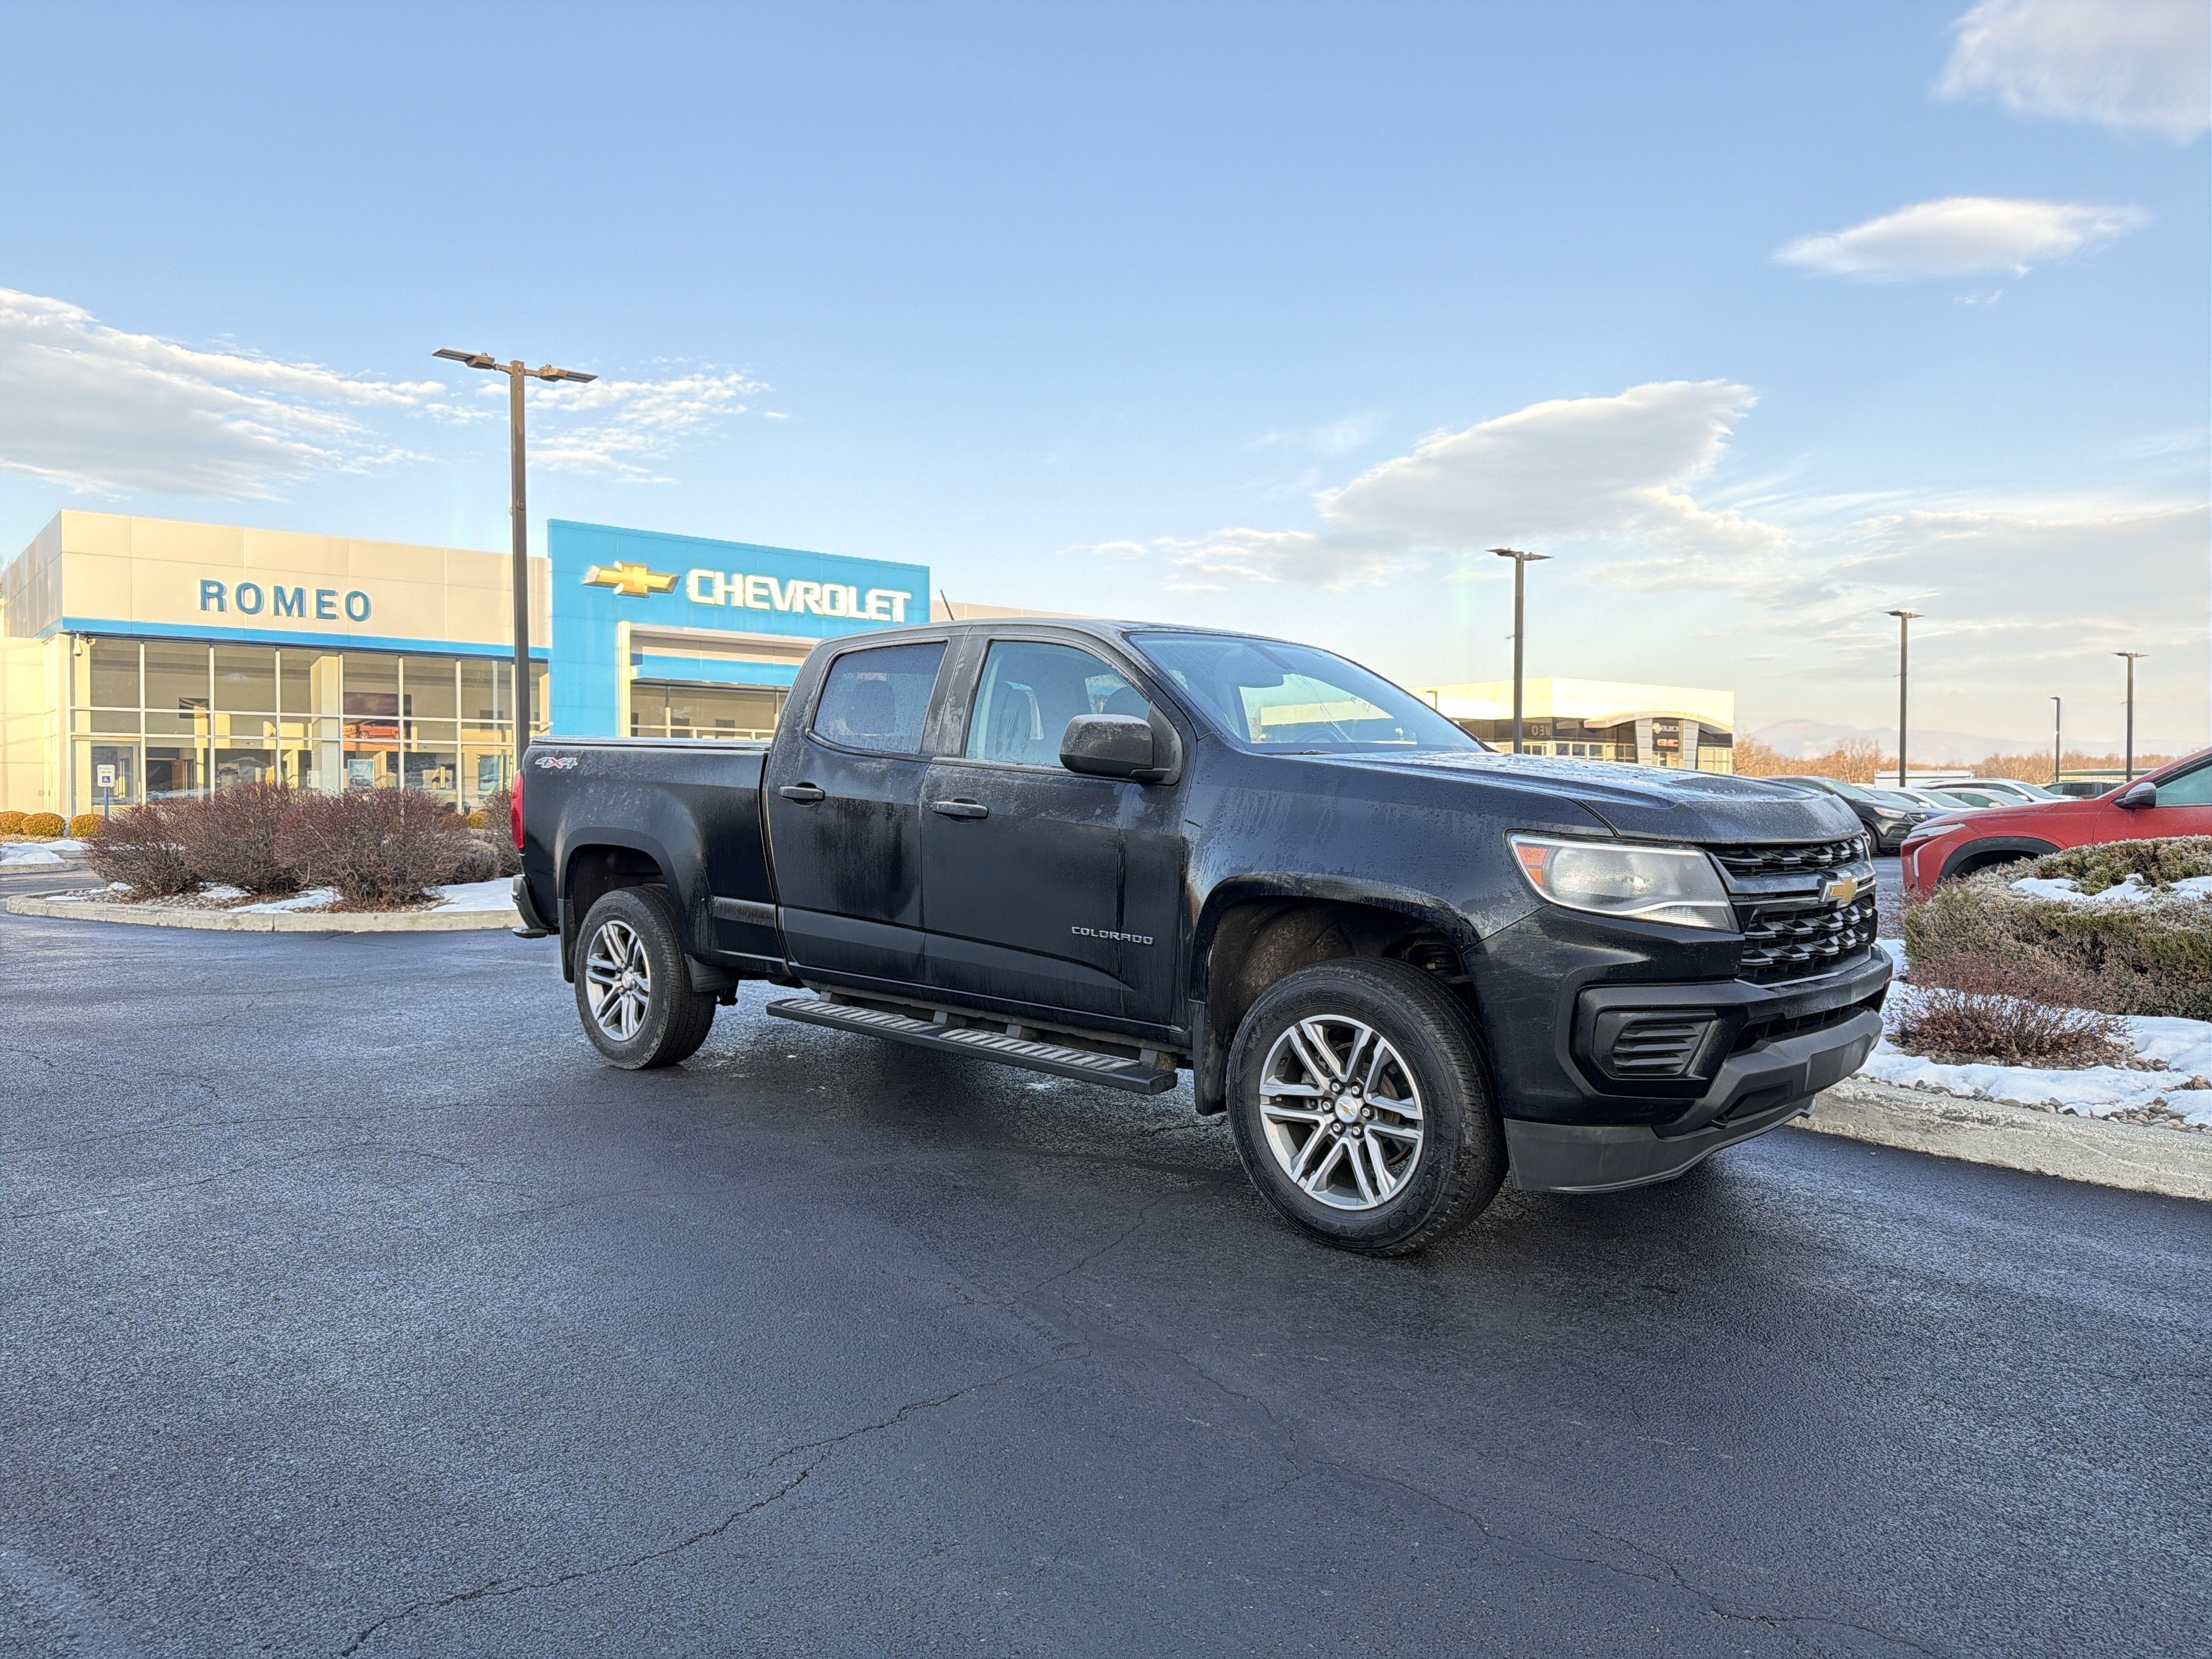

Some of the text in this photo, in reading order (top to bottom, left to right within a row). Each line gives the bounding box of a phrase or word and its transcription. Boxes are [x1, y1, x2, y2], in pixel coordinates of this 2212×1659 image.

[199, 579, 372, 622] ROMEO
[688, 569, 911, 623] CHEVROLET
[1071, 926, 1153, 945] COLORADO
